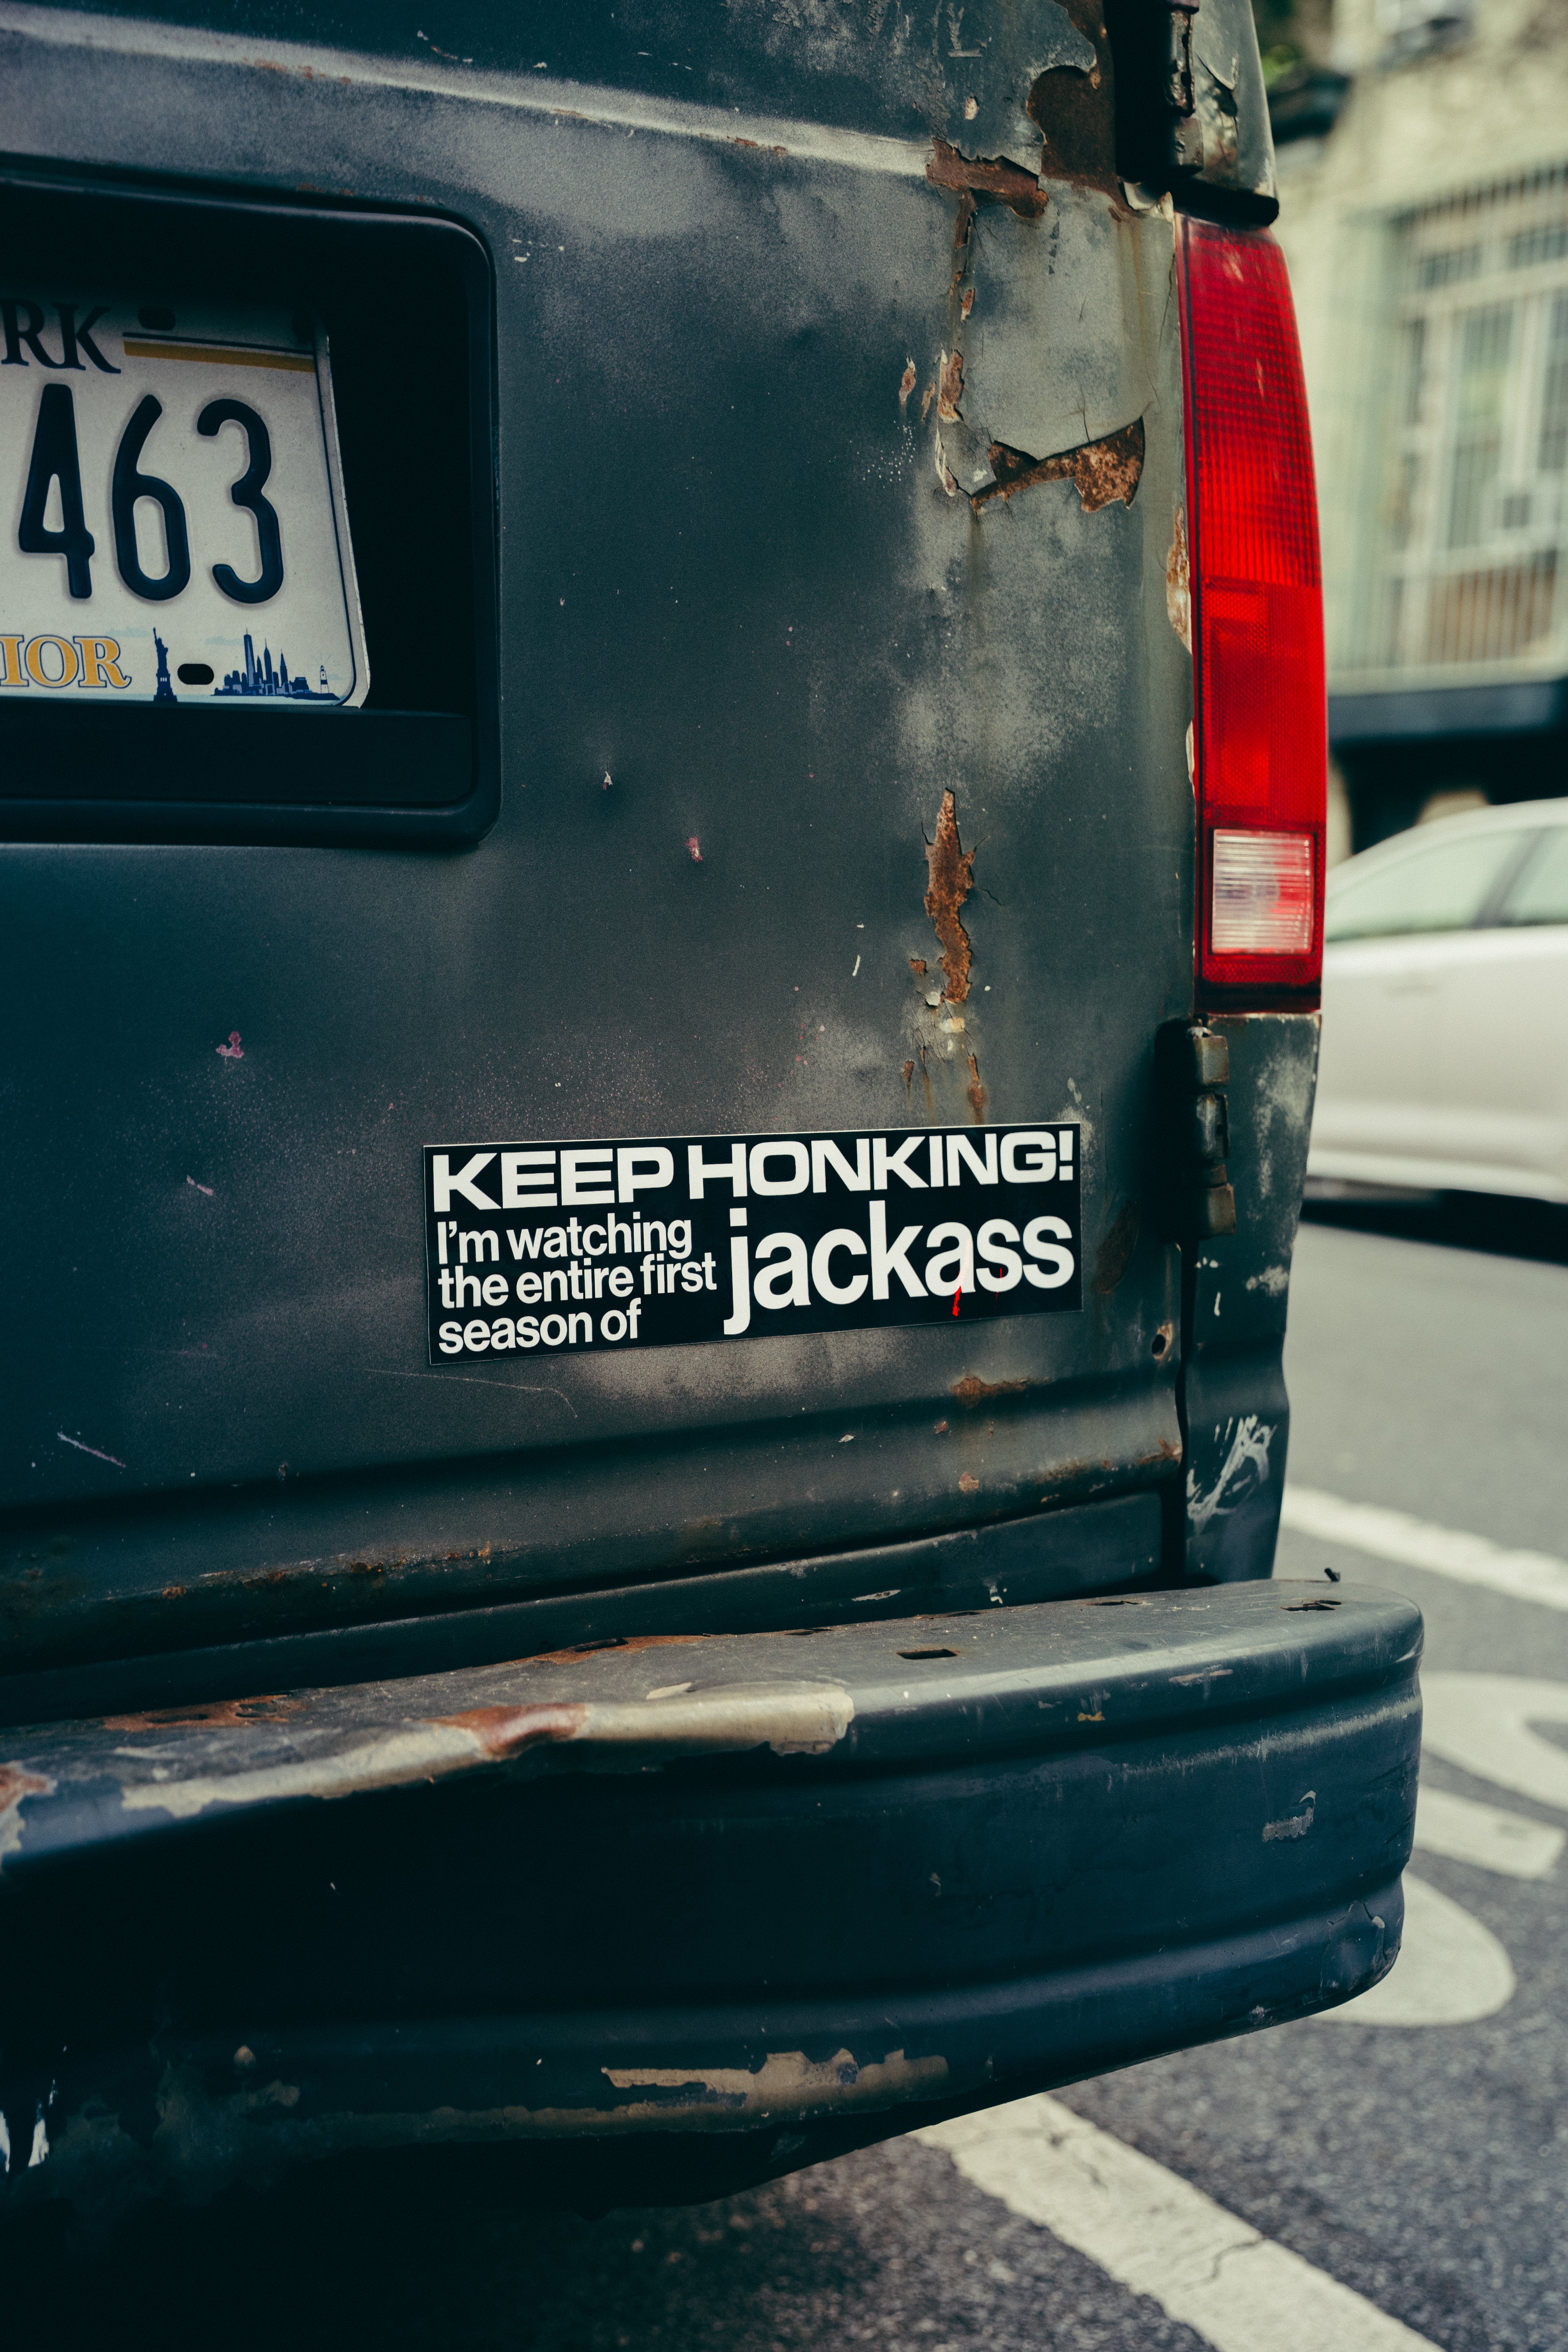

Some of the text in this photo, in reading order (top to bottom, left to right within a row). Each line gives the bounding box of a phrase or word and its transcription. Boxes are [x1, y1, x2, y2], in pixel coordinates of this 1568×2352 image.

[0, 298, 121, 374] RK
[18, 384, 284, 604] 463
[0, 634, 132, 688] IOR
[433, 1131, 1073, 1212] KEEP HONKING!
[506, 1212, 692, 1259] watching
[724, 1200, 1075, 1335] jackass
[438, 1252, 717, 1308] the entire first
[439, 1297, 641, 1353] season of
